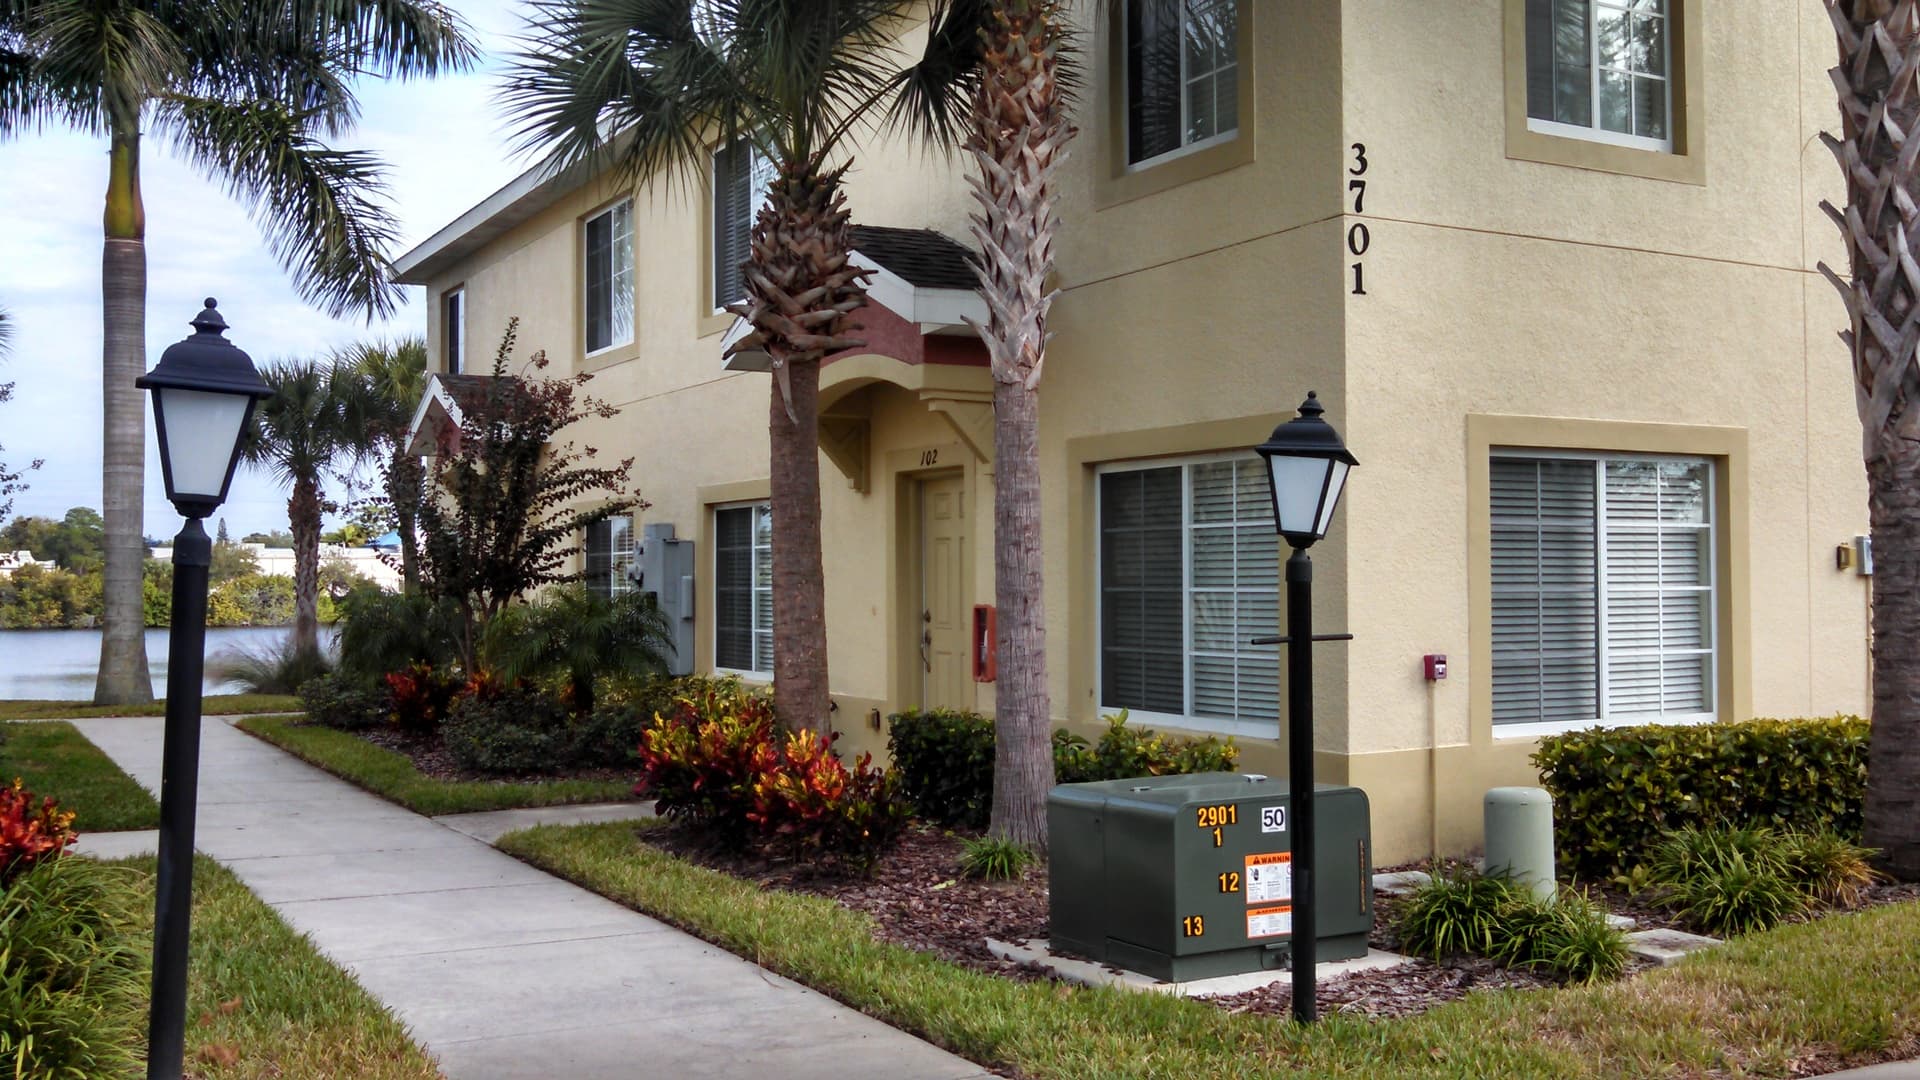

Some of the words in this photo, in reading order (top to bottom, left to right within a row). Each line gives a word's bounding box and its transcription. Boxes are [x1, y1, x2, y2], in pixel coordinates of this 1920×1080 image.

[1348, 142, 1370, 295] 3701
[920, 449, 938, 467] 102
[1198, 804, 1236, 828] 2901
[1263, 808, 1284, 827] 50
[1213, 827, 1222, 847] 1
[1261, 855, 1291, 864] WARNIN
[1219, 872, 1239, 892] 12
[1183, 916, 1204, 936] 13
